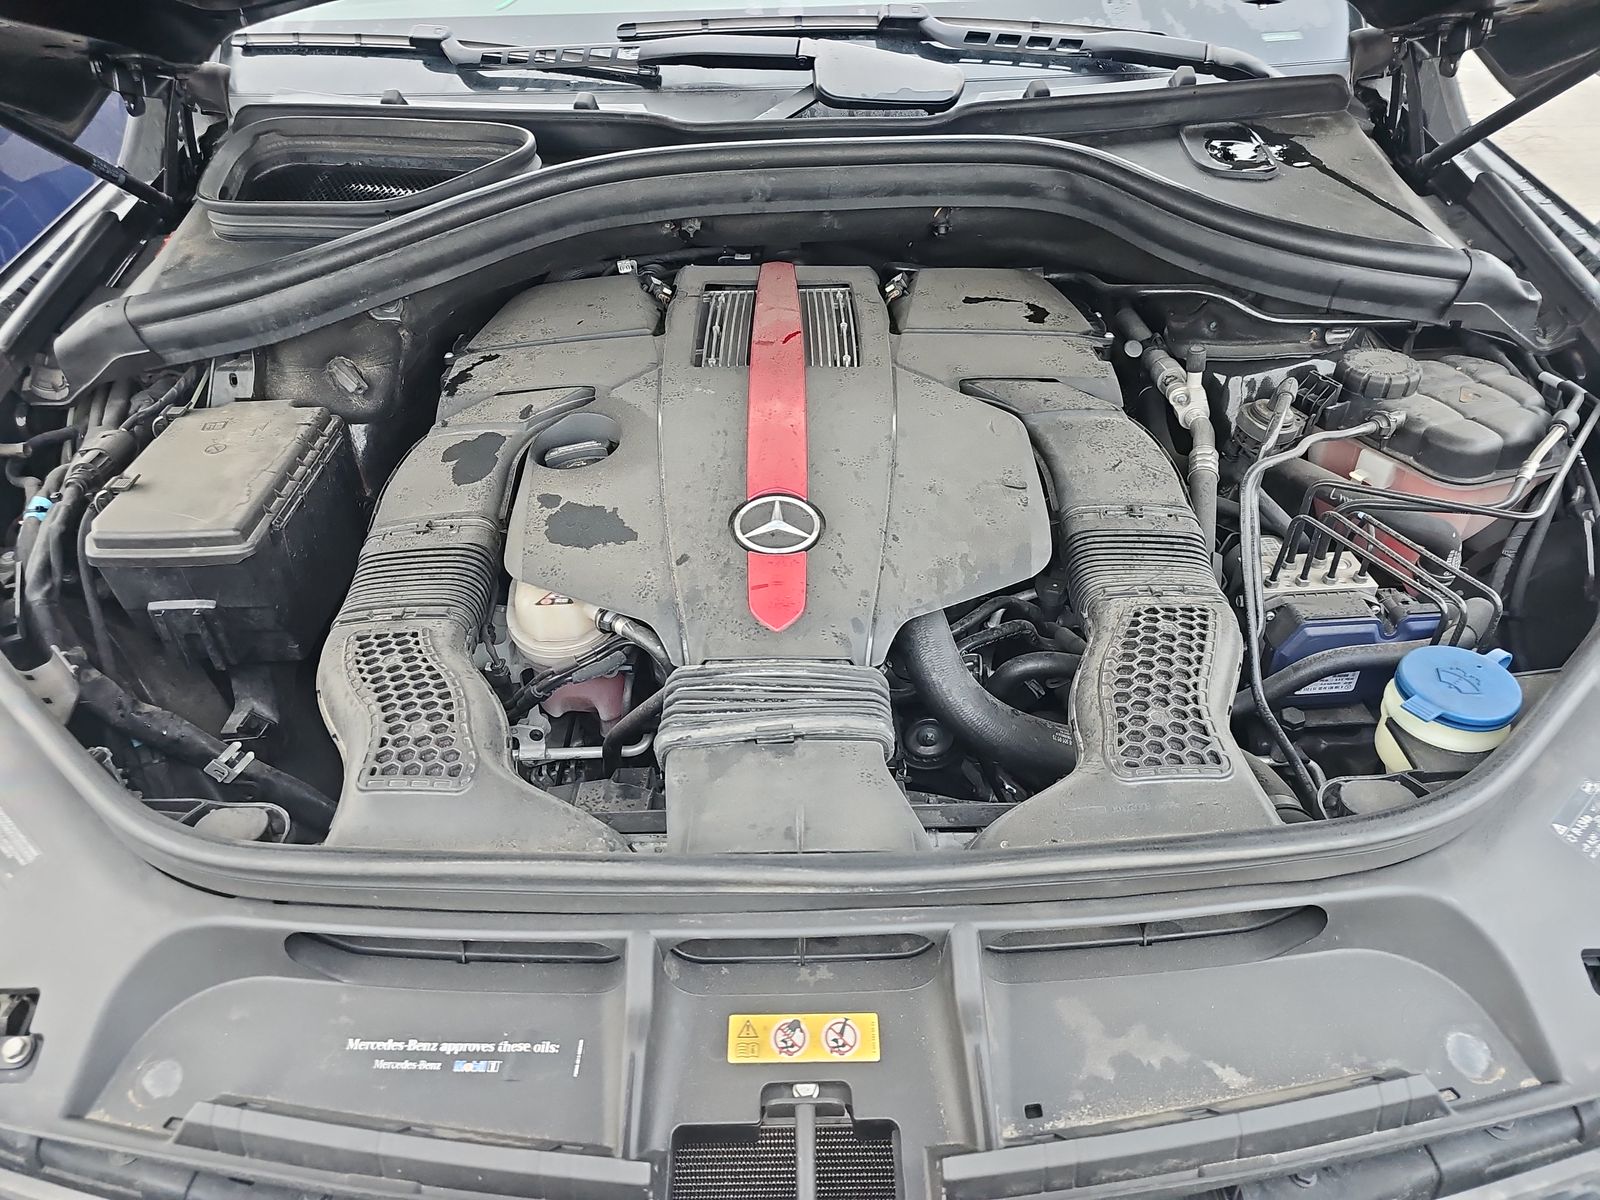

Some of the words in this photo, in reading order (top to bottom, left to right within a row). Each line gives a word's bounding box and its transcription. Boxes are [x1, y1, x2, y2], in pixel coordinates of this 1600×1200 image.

[346, 1039, 438, 1052] Mercedes-Benz
[439, 1042, 495, 1055] approves
[497, 1041, 531, 1052] these
[533, 1041, 560, 1053] oils:
[373, 1059, 442, 1070] Mercedes-Benz
